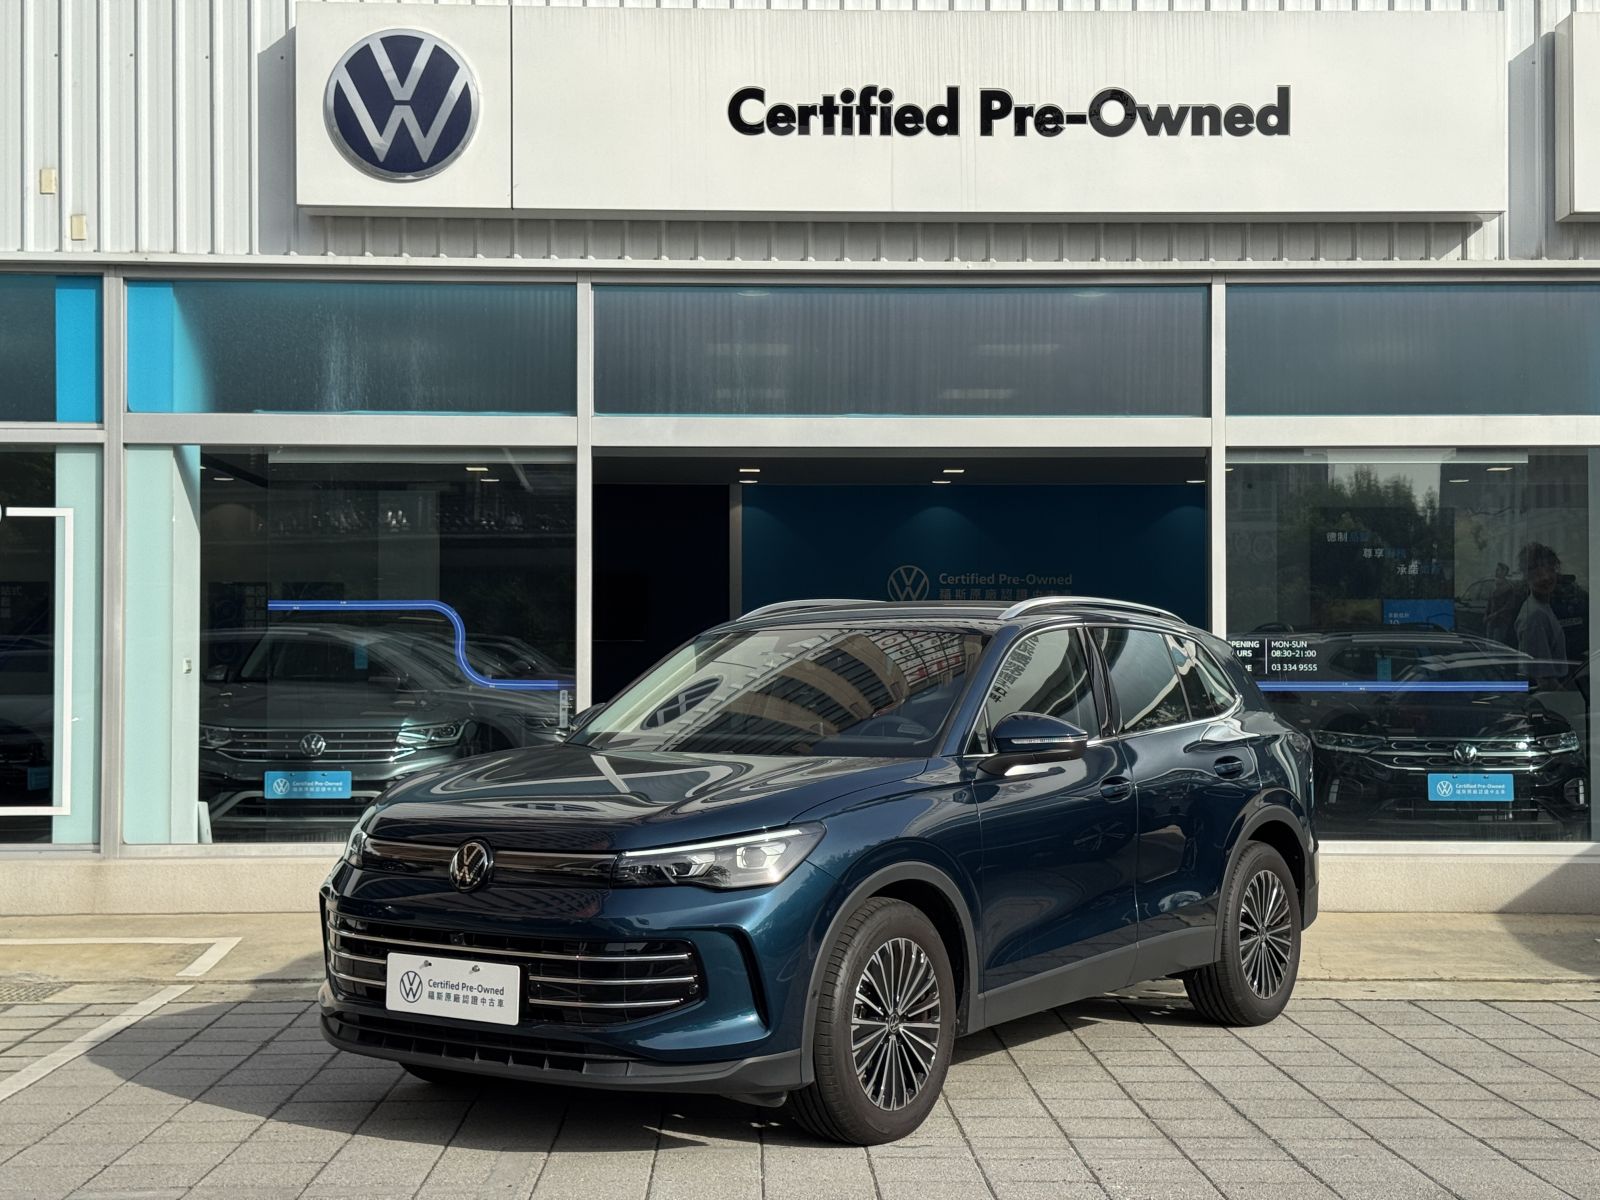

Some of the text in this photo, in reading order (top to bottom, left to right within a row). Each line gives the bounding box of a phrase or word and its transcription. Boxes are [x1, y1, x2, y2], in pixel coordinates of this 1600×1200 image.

[727, 85, 1291, 138] Certified Pre-Owned
[938, 572, 1073, 585] Certified Pre-Owned
[1271, 640, 1308, 649] MON-SUN
[1236, 649, 1317, 658] URS 08:30-21:00
[1271, 663, 1318, 672] 03 334 9555
[428, 979, 505, 996] Certified Pre-Owned
